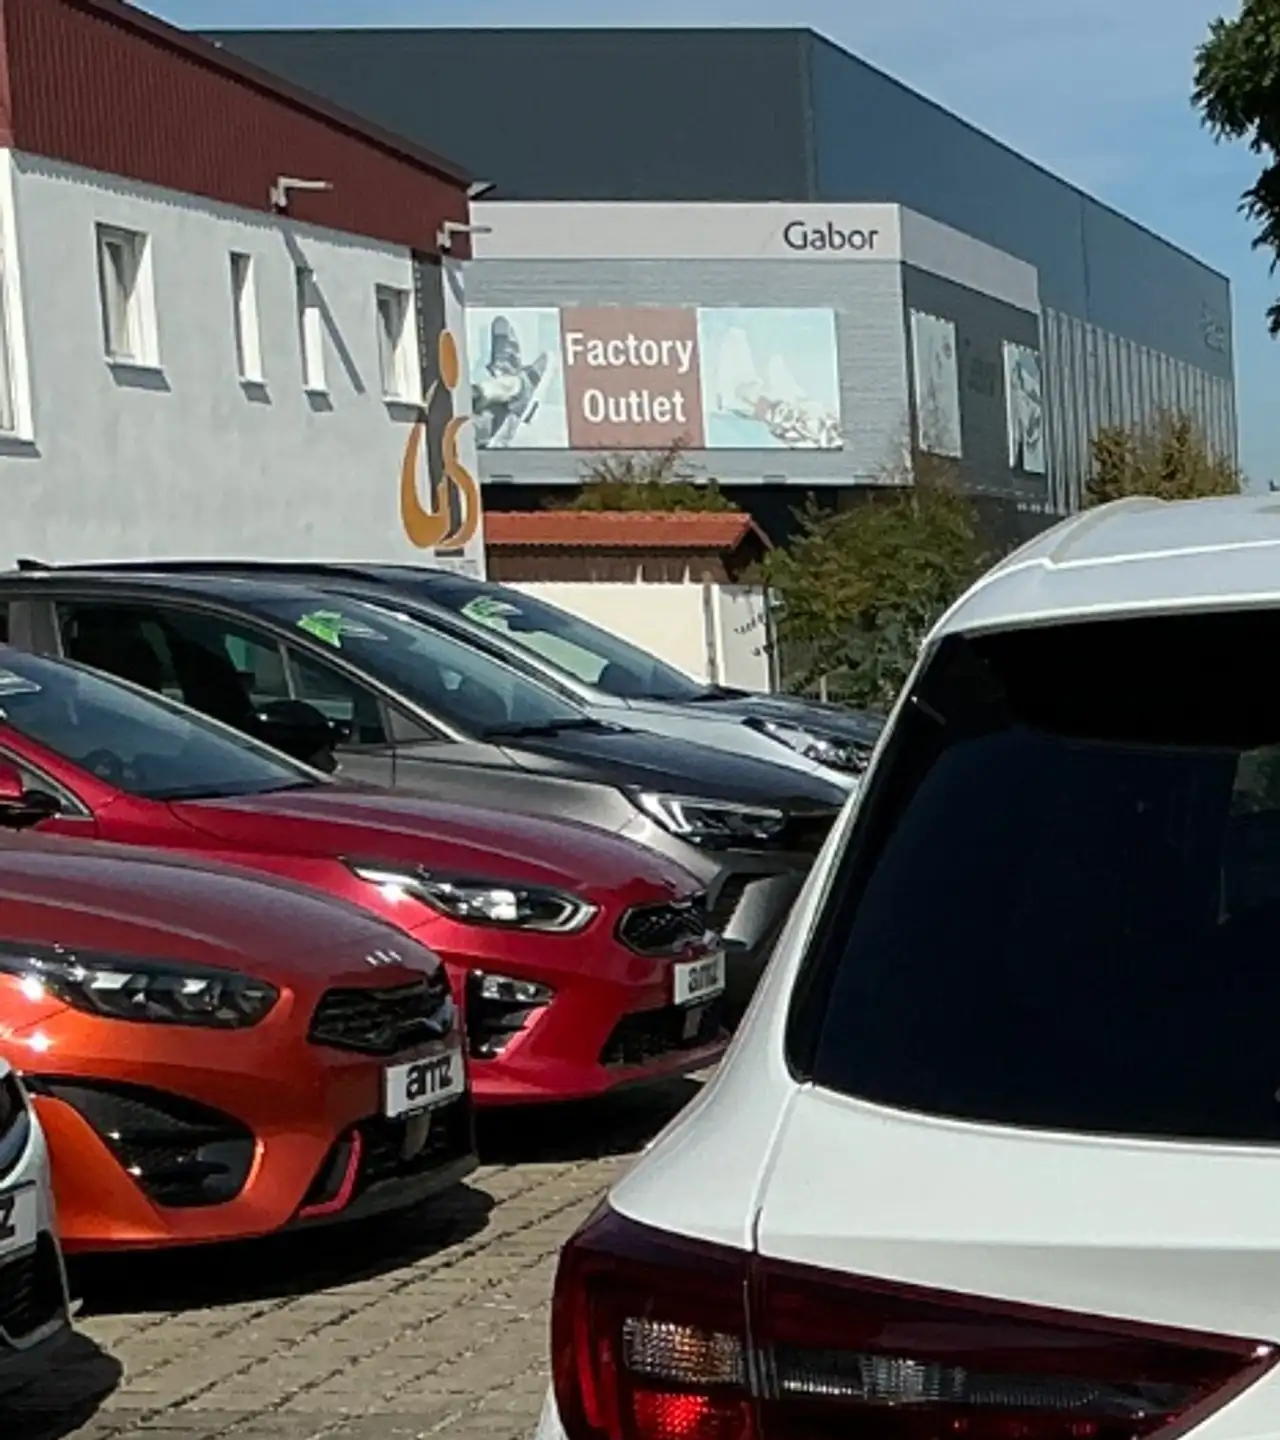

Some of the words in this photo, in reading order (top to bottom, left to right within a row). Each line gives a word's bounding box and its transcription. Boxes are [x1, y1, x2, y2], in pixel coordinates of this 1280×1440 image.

[783, 220, 878, 251] Gabor
[564, 332, 694, 374] Factory
[582, 389, 687, 424] Outlet
[406, 1054, 454, 1101] amz
